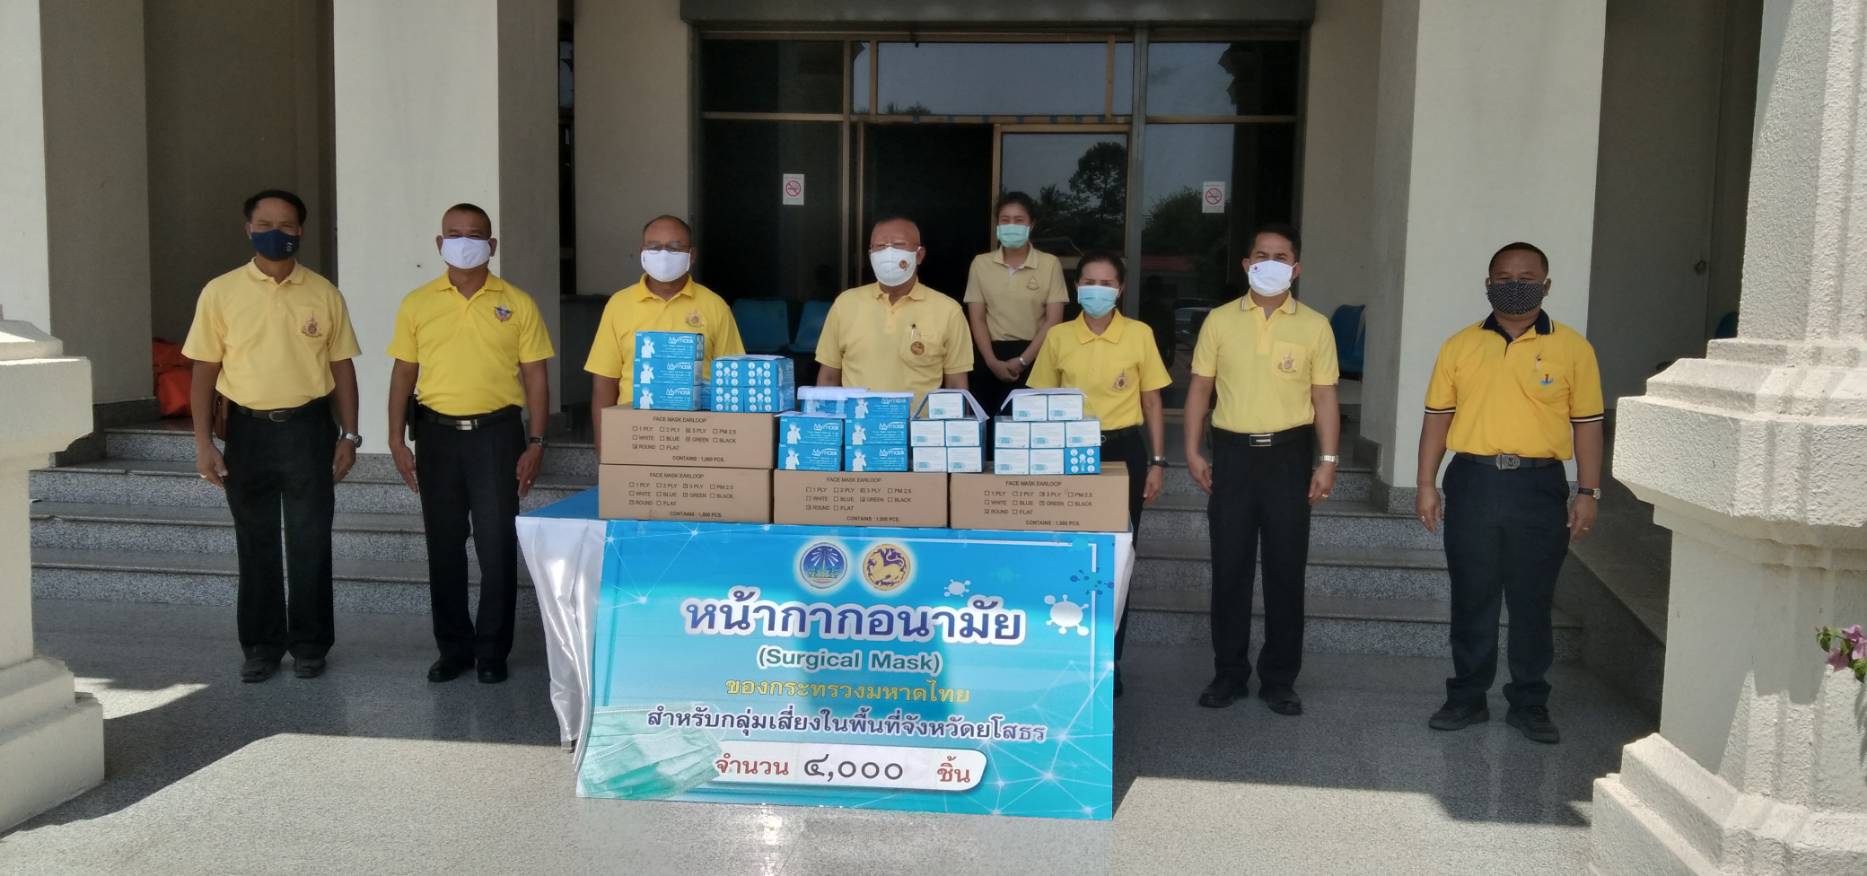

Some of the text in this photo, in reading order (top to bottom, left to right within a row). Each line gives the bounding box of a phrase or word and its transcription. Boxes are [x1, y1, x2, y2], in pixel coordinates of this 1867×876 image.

[686, 590, 1021, 640] หน้ากากอนามัย
[759, 648, 941, 673] (Surgical Mask)
[648, 705, 1046, 741] สำหรับกลุ่มเสี่ยงในพื้นที่จังหวัดยโสธร
[715, 753, 970, 783] จำนวน ๔,๐๐๐ ชิ้น
